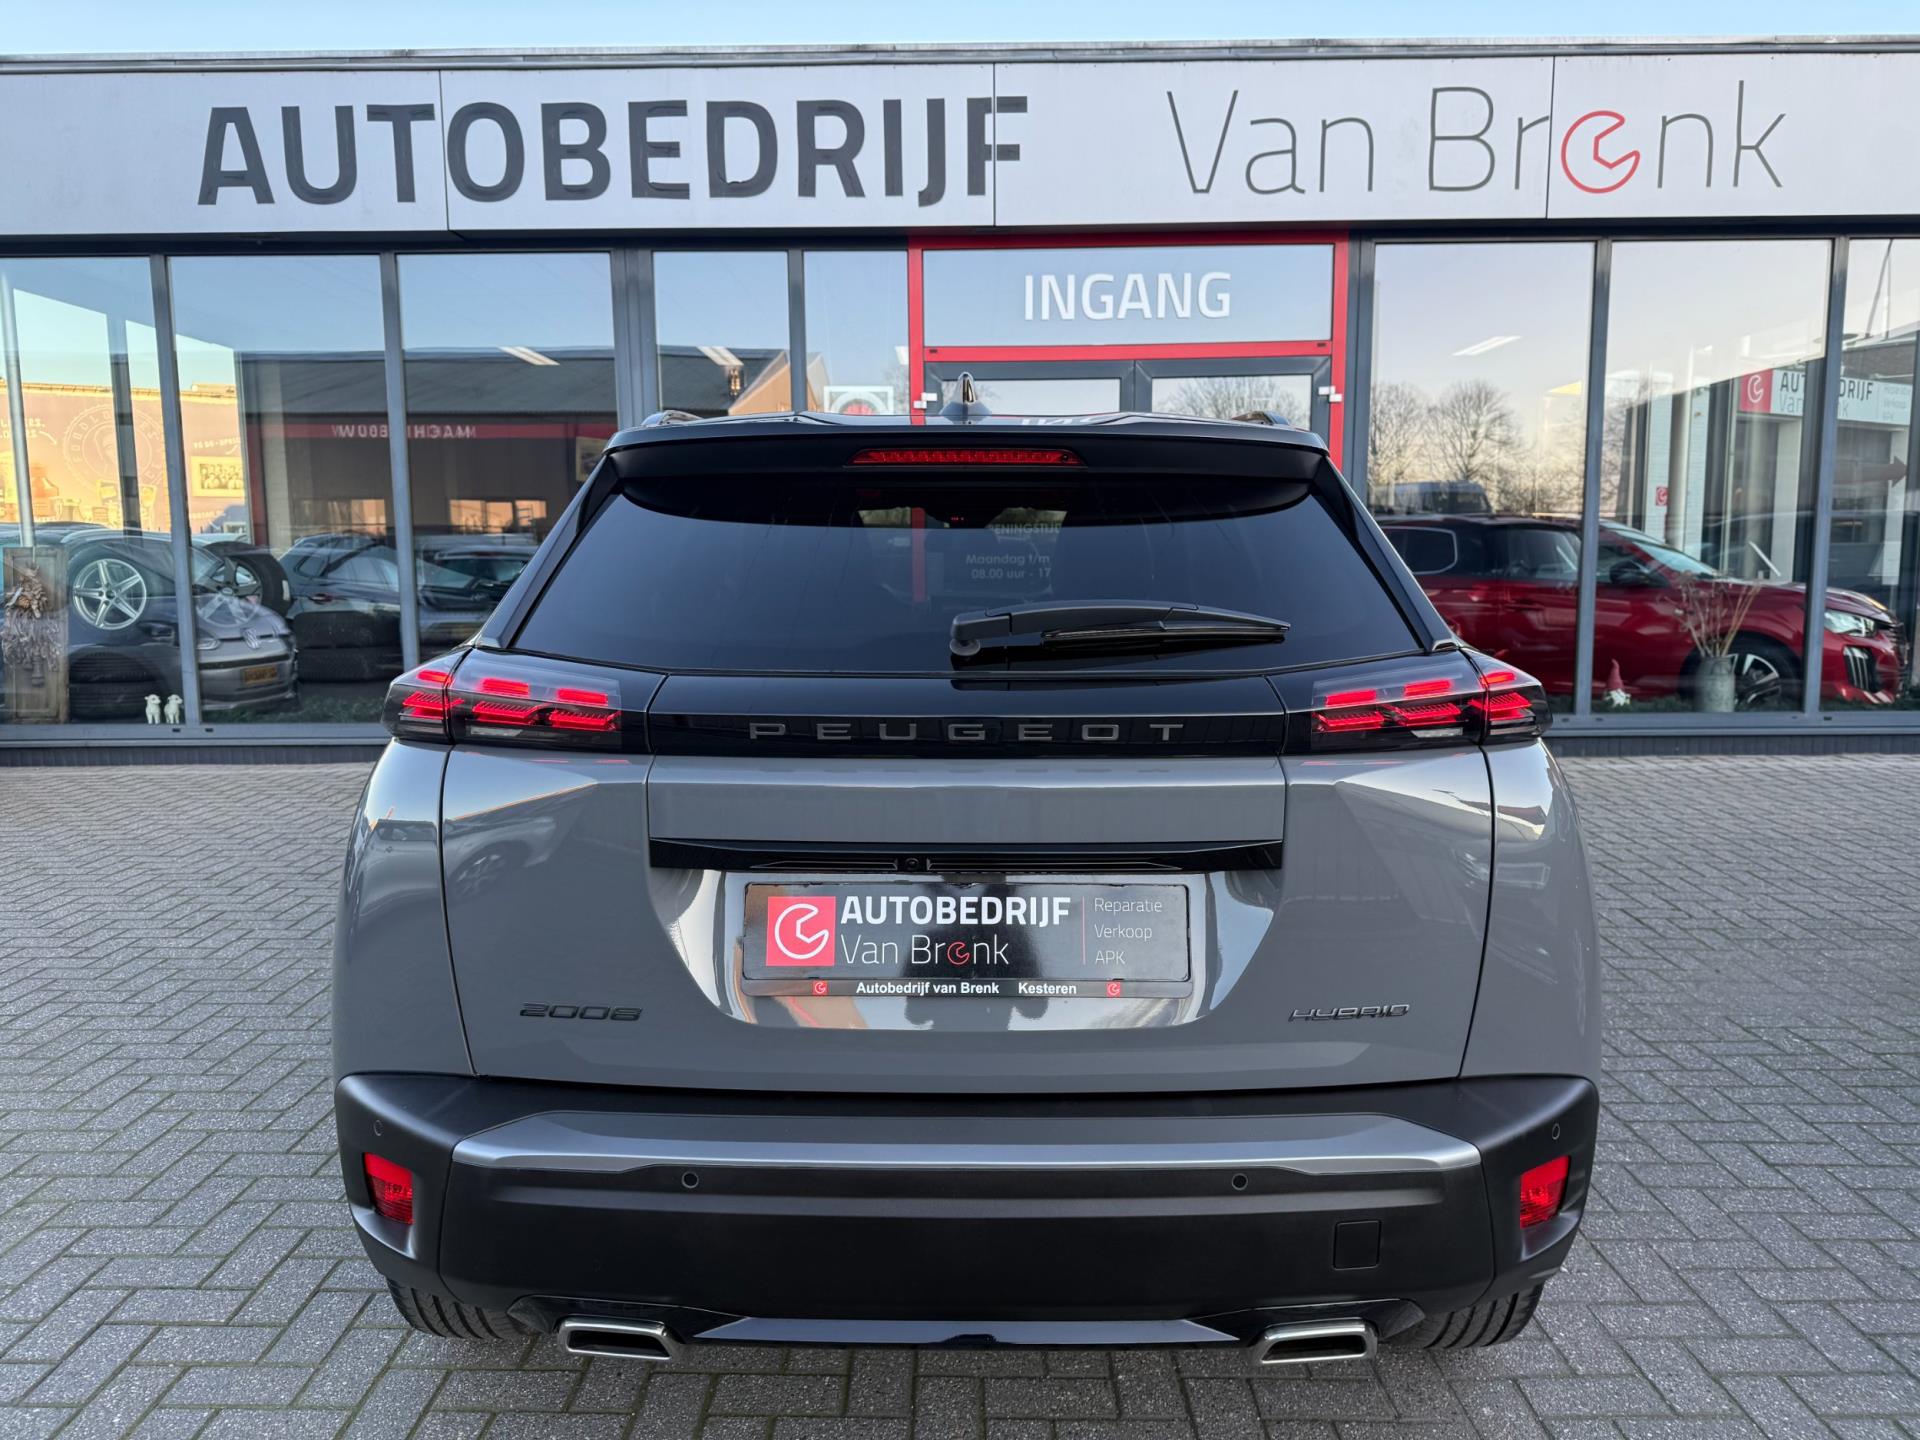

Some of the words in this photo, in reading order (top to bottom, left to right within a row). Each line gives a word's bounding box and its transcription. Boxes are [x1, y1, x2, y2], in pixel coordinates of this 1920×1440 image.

[1167, 90, 1374, 194] Van
[197, 96, 1028, 207] AUTOBEDRIJF
[1025, 272, 1231, 320] INGANG
[966, 554, 1025, 566] Maandag
[1006, 569, 1025, 578] uur
[749, 723, 1184, 741] PEUGEOT
[841, 896, 1071, 927] AUTOBEDRIJF
[1095, 898, 1163, 914] Reparatie
[1095, 925, 1153, 941] Verkoop
[841, 935, 898, 965] Van
[1095, 950, 1126, 965] APK
[856, 982, 930, 996] Autobedrijf
[933, 984, 958, 994] van
[961, 982, 999, 994] Brenk
[1018, 982, 1077, 995] Kesteren
[520, 1002, 643, 1021] 2008
[1288, 1004, 1410, 1021] HYBRID
